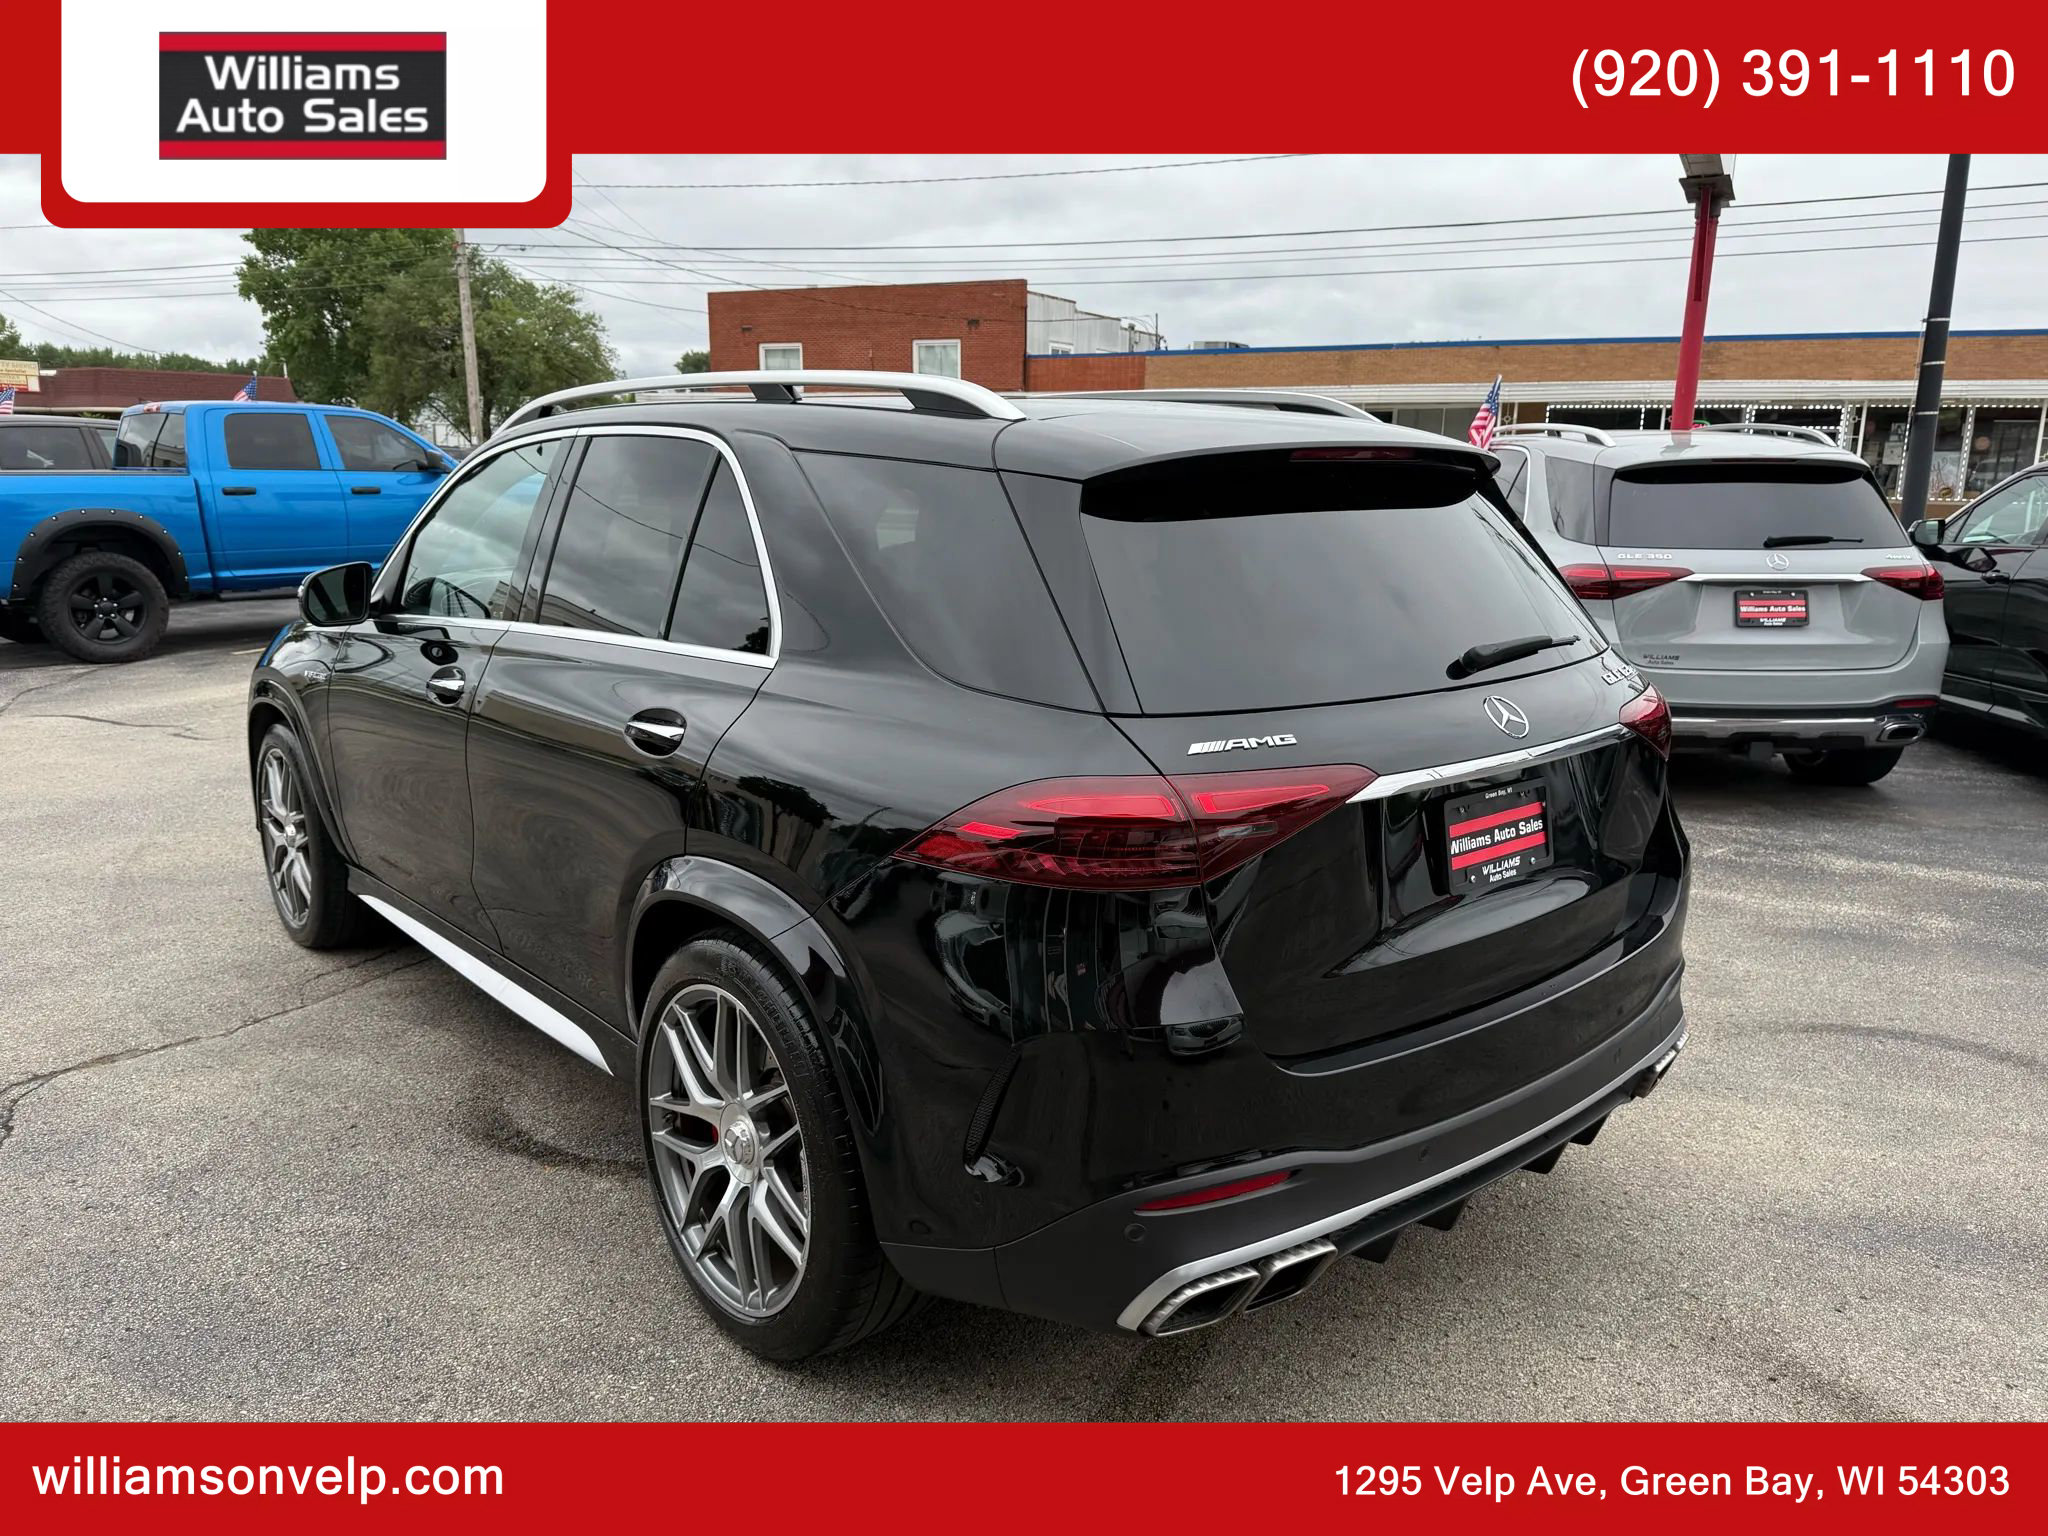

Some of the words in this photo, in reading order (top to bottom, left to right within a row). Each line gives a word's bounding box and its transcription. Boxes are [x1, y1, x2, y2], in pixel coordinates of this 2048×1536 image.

[1224, 734, 1297, 752] AMG
[1450, 834, 1492, 855] Williams
[1494, 827, 1516, 843] Auto
[1519, 819, 1543, 835] Sales
[1482, 856, 1520, 875] WILLIAMS
[1489, 873, 1503, 883] Auto
[1502, 868, 1517, 879] Sales
